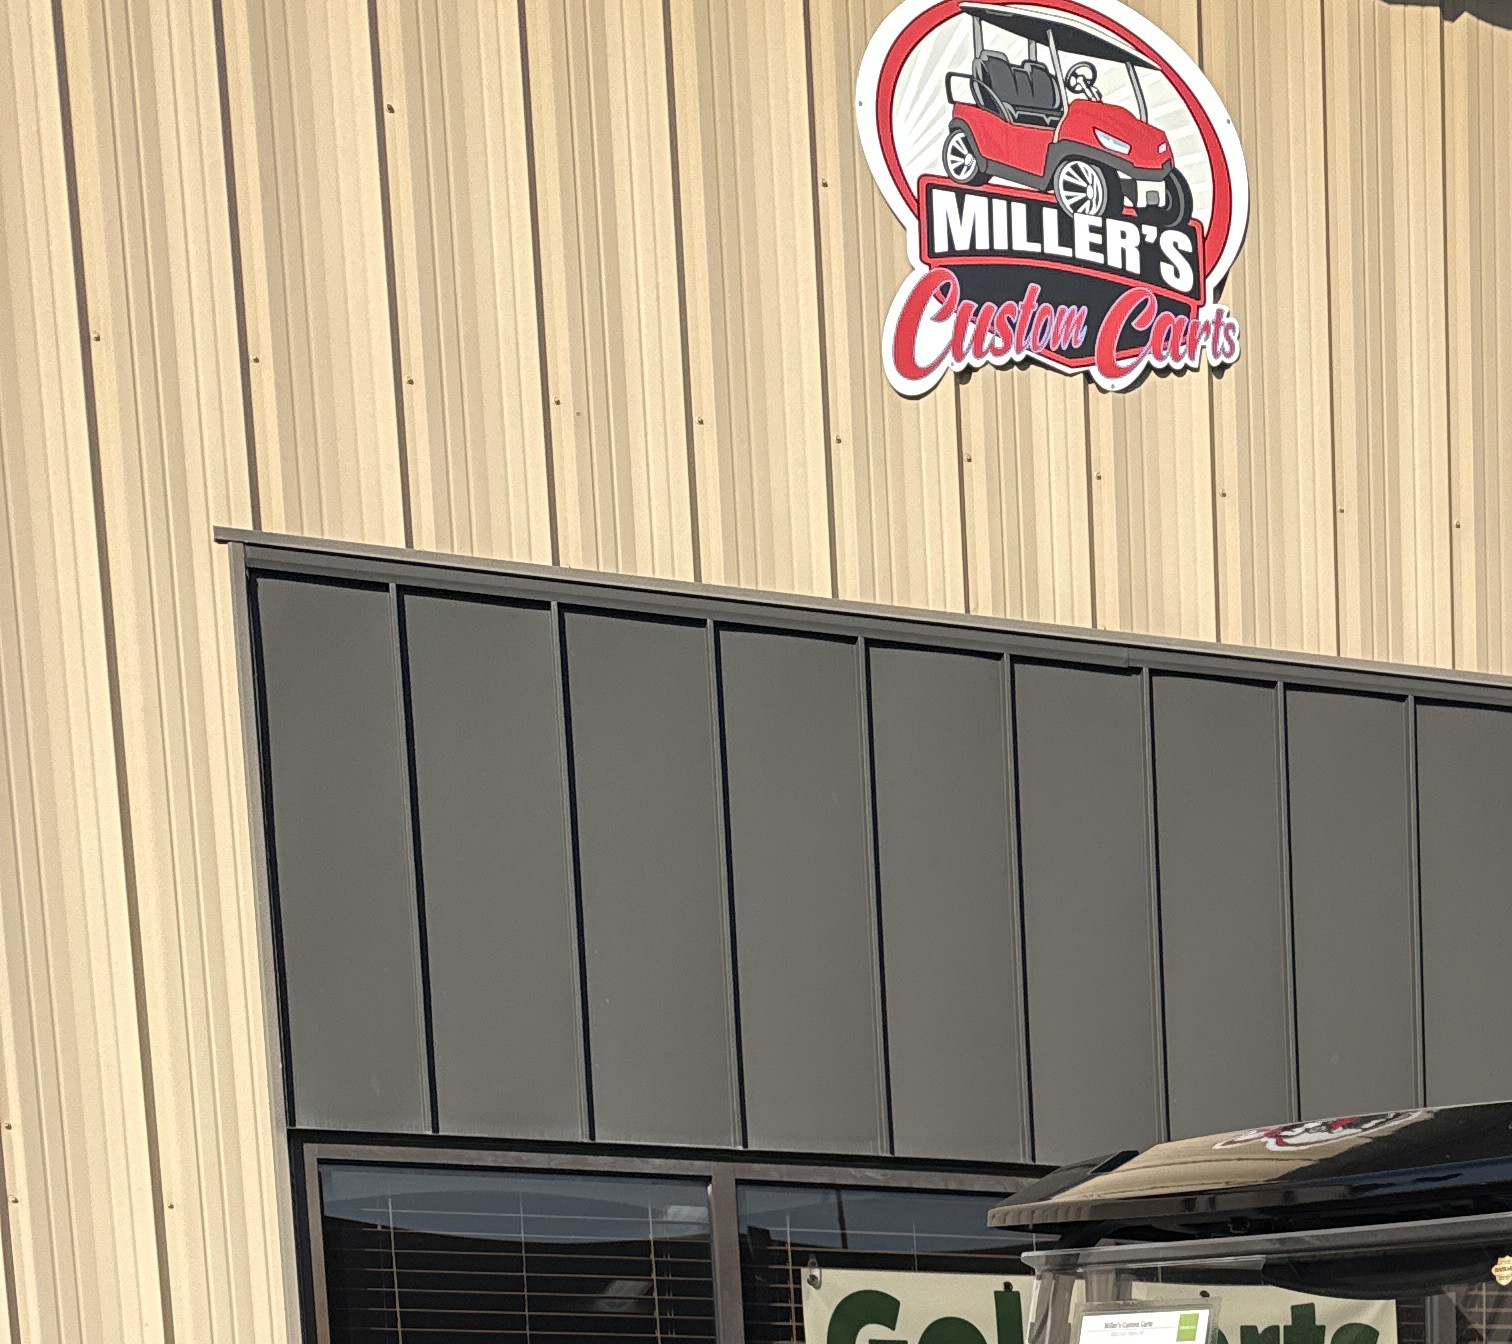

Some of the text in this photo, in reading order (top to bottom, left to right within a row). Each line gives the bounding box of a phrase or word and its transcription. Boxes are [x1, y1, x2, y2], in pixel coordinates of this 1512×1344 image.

[932, 188, 1195, 294] MILLER'S
[893, 266, 1239, 381] Custom Carts
